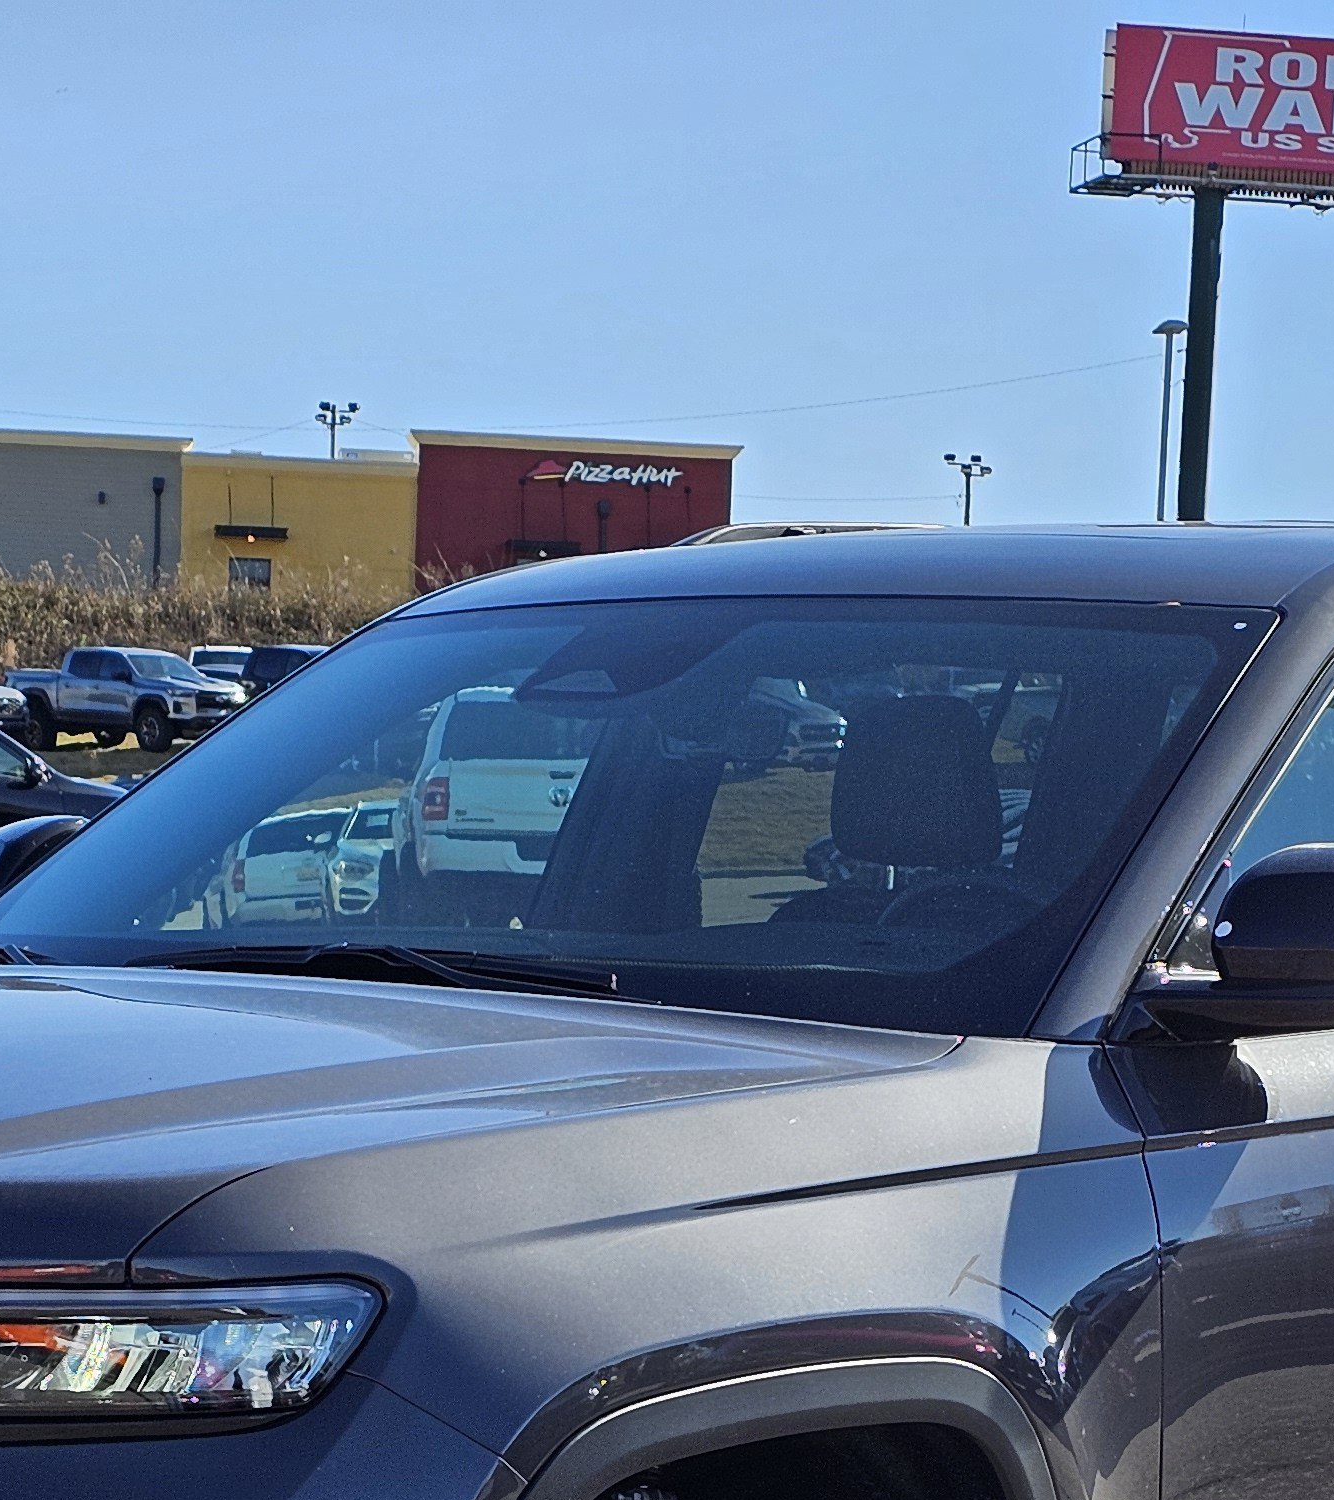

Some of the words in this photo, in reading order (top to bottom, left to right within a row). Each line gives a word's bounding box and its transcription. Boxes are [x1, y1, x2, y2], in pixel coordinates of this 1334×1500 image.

[1239, 130, 1303, 151] US
[564, 460, 632, 483] Pizza
[630, 463, 684, 487] Hut
